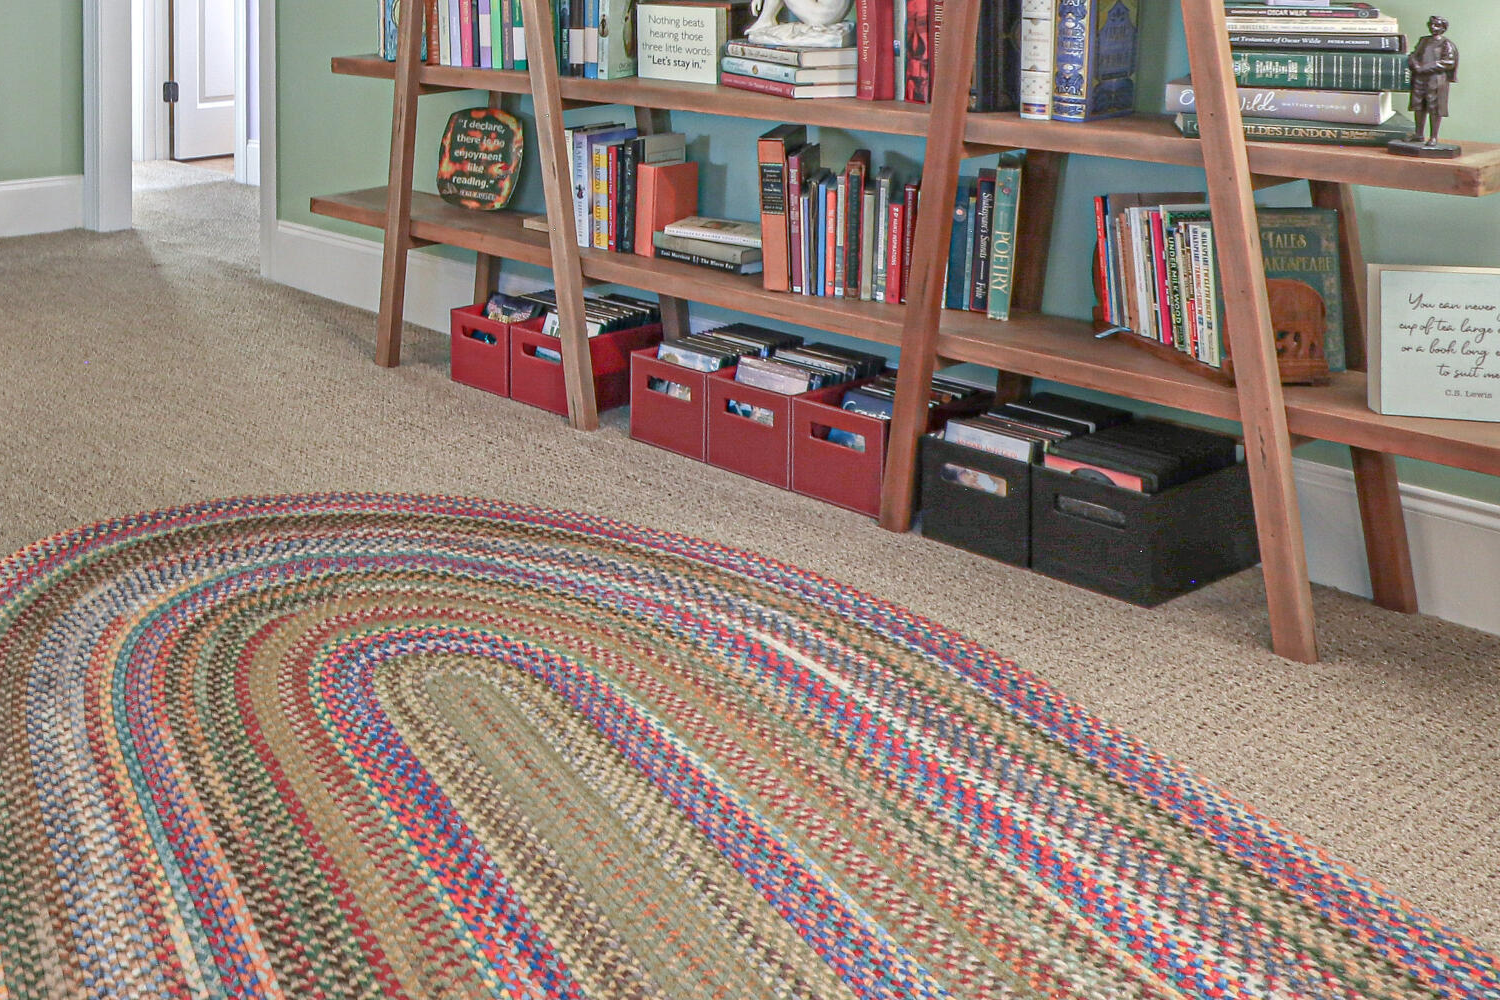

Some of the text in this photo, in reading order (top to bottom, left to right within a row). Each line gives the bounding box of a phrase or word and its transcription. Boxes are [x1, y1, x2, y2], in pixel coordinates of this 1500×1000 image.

[648, 15, 705, 28] Nothing beats
[650, 29, 704, 42] hearing those
[861, 23, 870, 63] Chekhov
[642, 42, 663, 52] three
[665, 43, 683, 53] little
[647, 54, 706, 70] "Let's stay in."
[1240, 91, 1279, 112] ilde
[469, 120, 505, 134] declare,
[1285, 126, 1338, 139] LONDON
[456, 134, 480, 144] there
[492, 138, 505, 148] no
[454, 149, 502, 162] enjoyment
[467, 162, 485, 174] like
[452, 176, 495, 189] reading."
[976, 192, 993, 299] Shakespeare's Sonnets Folio
[1262, 231, 1307, 249] TALES
[671, 252, 691, 261] Morrison
[991, 230, 1011, 294] POETRY
[1264, 256, 1332, 272] AKESPEARE
[1168, 236, 1182, 324] UNDER MILK WOOD
[1408, 292, 1496, 311] You can never
[1399, 316, 1494, 344] cup of tea large
[1429, 338, 1458, 354] book
[1461, 340, 1489, 366] long
[1436, 364, 1451, 377] to
[1453, 366, 1484, 379] suit
[1444, 390, 1493, 399] C.S. Lewis
